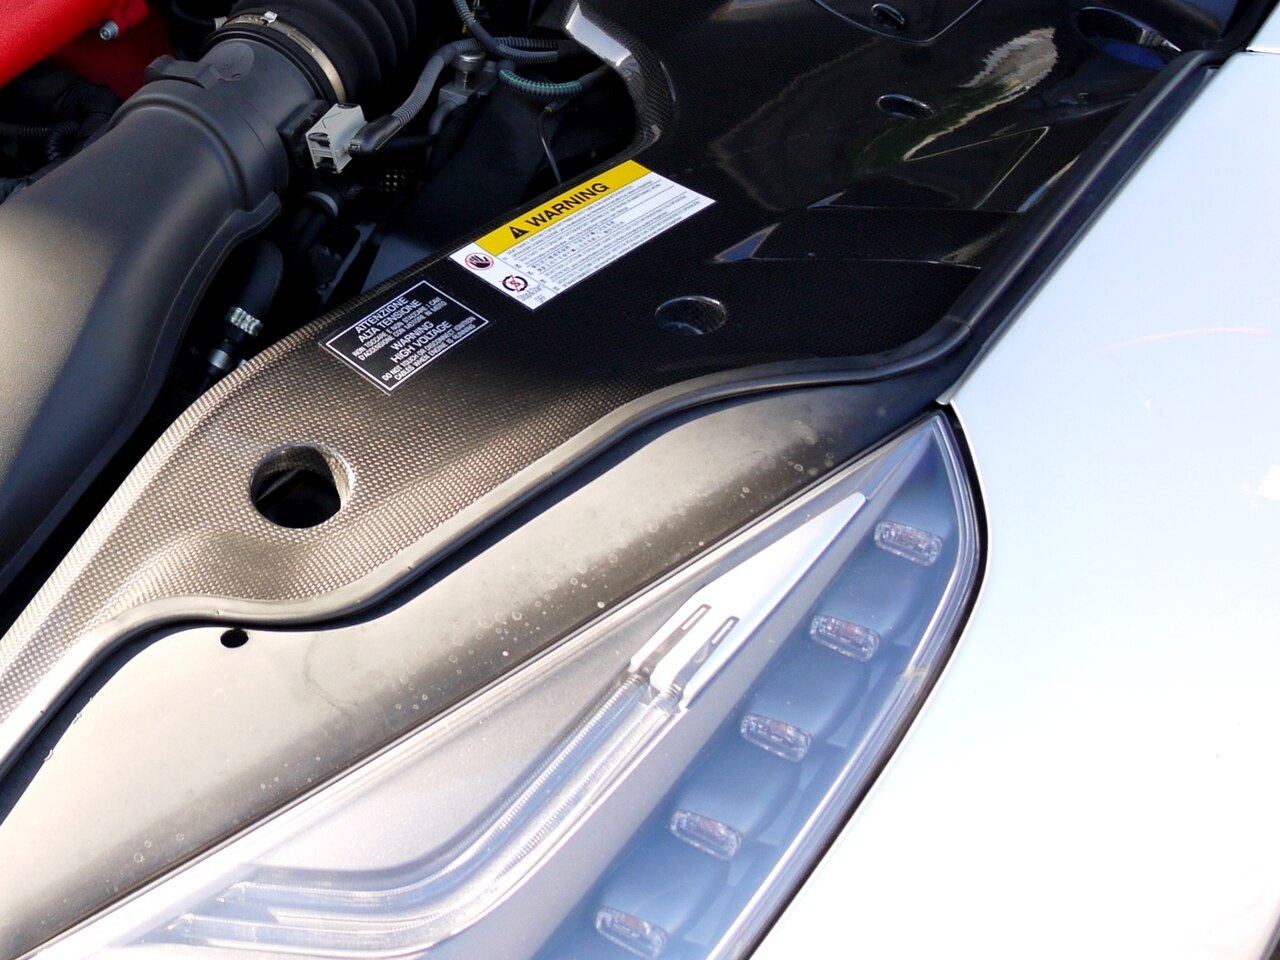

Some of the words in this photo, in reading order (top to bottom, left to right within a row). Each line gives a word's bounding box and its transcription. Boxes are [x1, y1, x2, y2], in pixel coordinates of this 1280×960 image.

[525, 183, 609, 226] WARNING
[355, 295, 408, 333] ATTENZIONE
[358, 327, 380, 343] ALTA
[376, 299, 422, 328] TENSIONE
[390, 321, 434, 350] WARNING
[390, 345, 415, 363] HIGH
[412, 321, 452, 347] VOLTAGE
